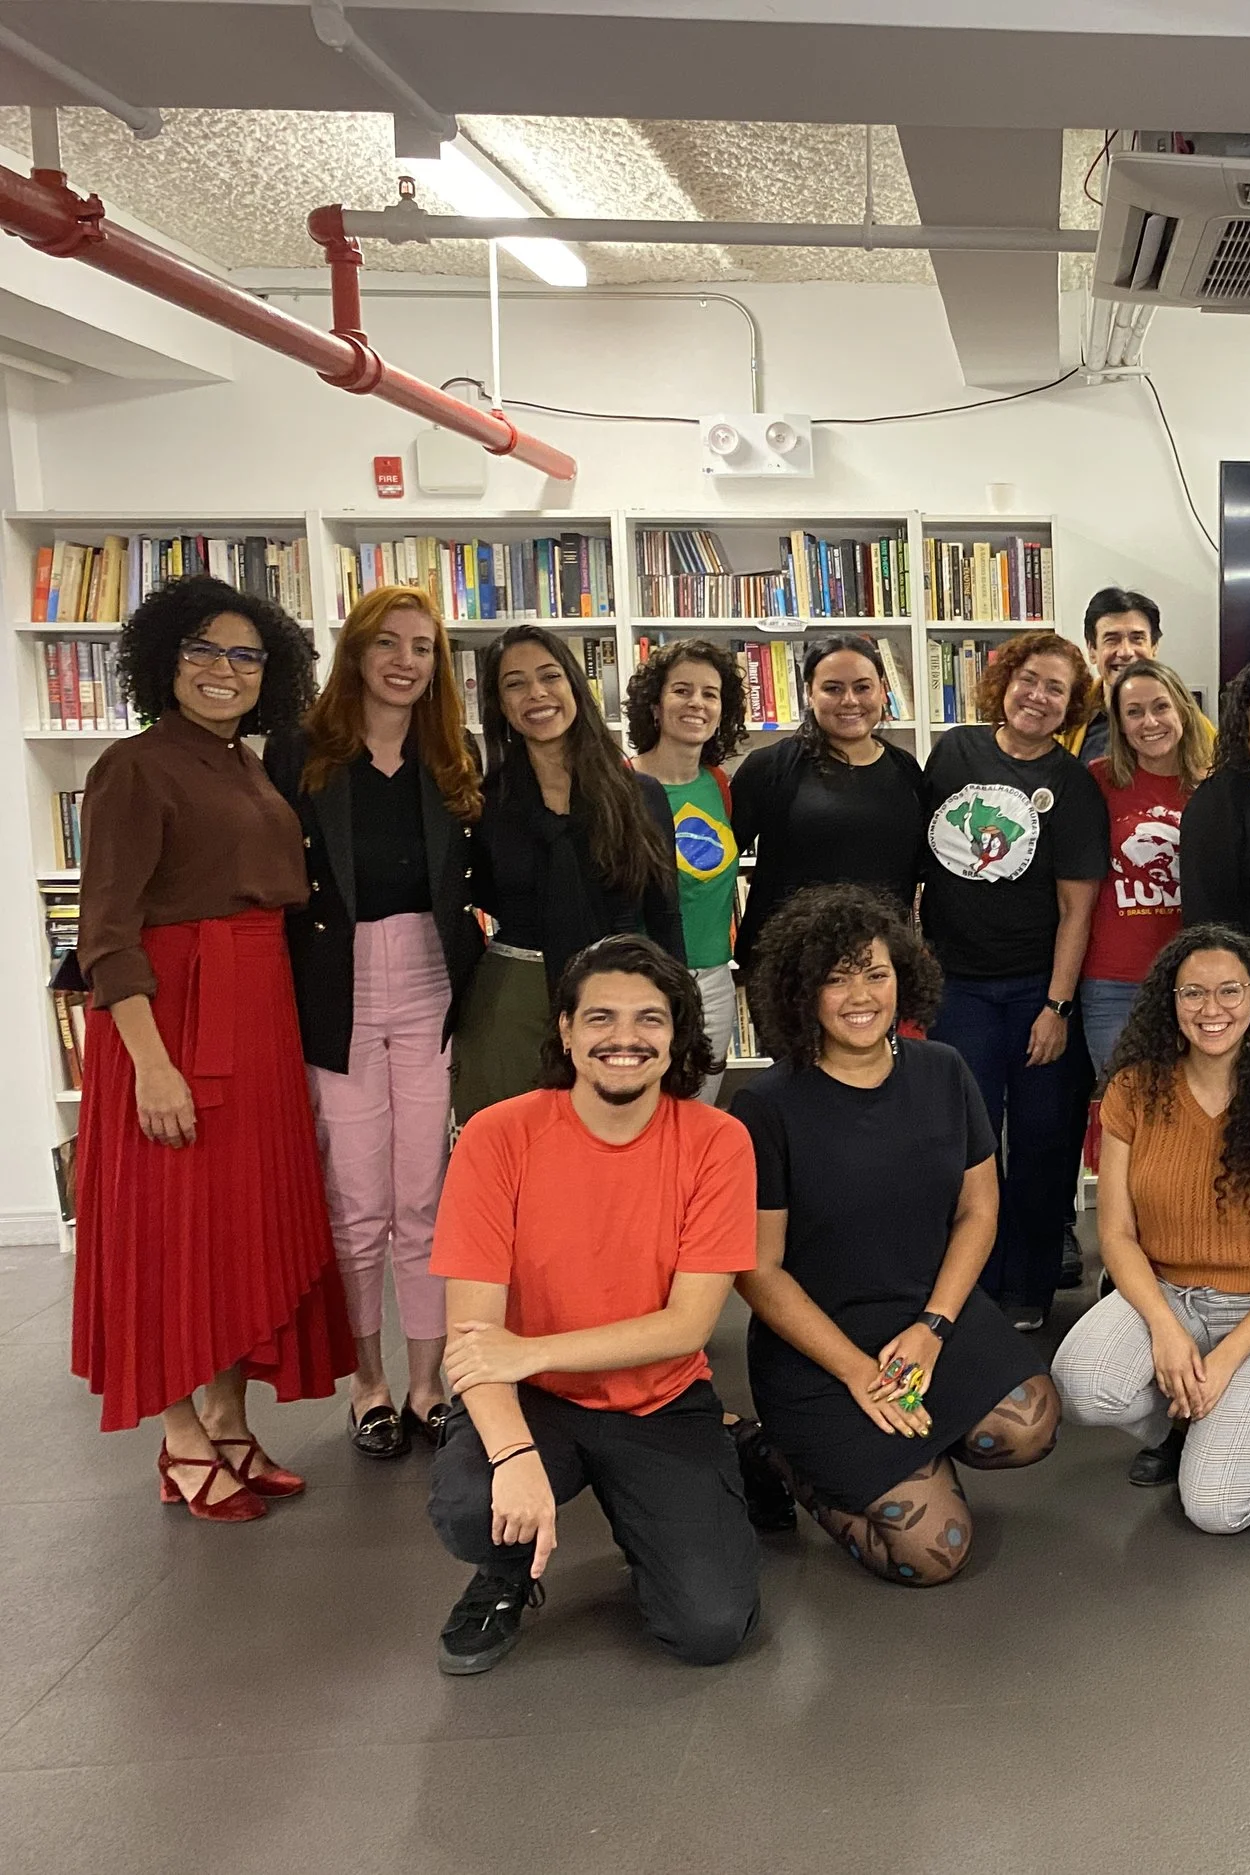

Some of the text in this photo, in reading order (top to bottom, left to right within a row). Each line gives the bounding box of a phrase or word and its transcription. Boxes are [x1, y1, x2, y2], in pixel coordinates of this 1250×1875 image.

[378, 475, 399, 483] FIRE
[930, 654, 940, 671] THE
[1126, 908, 1152, 916] BRASIL
